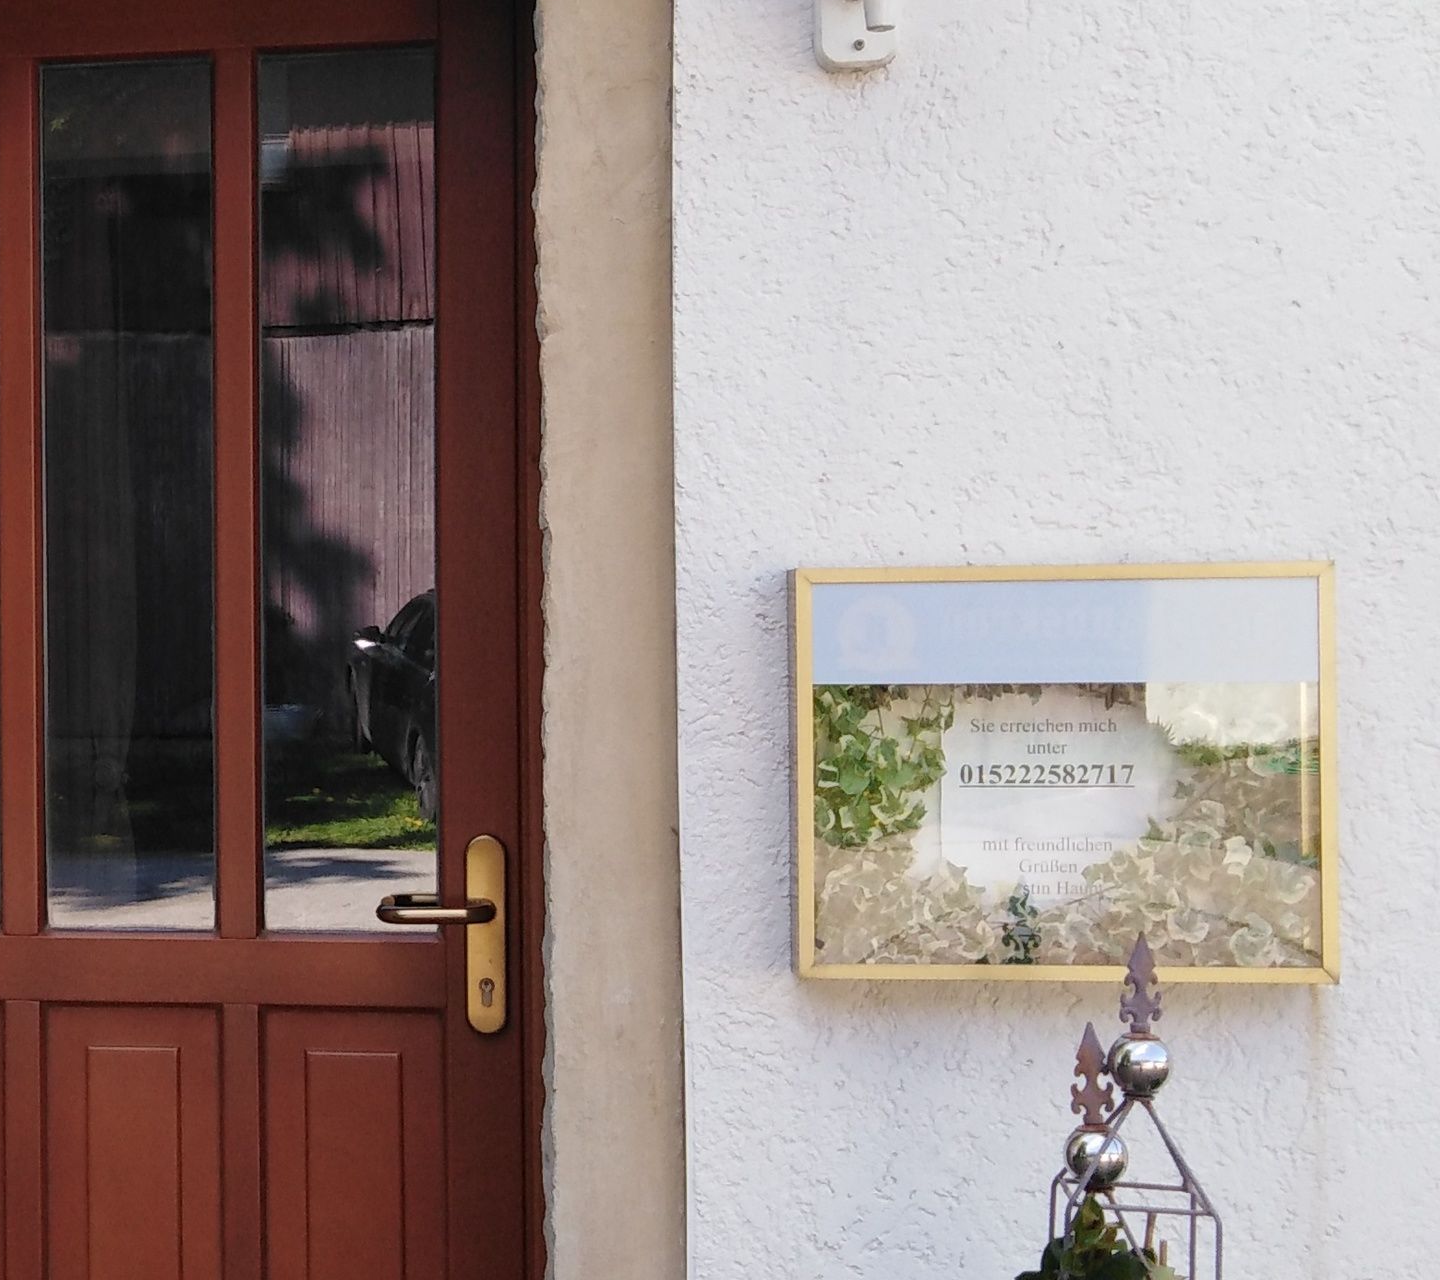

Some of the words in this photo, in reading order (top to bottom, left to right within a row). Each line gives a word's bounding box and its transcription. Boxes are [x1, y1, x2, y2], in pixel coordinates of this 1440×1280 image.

[970, 718, 995, 733] Sie
[999, 718, 1073, 733] erreichen
[1078, 718, 1118, 733] mich
[1026, 741, 1068, 755] unter
[959, 763, 1135, 786] 015222582717
[982, 838, 1010, 852] mit
[1014, 836, 1113, 852] freundlichen
[1018, 858, 1078, 873] Grüßen
